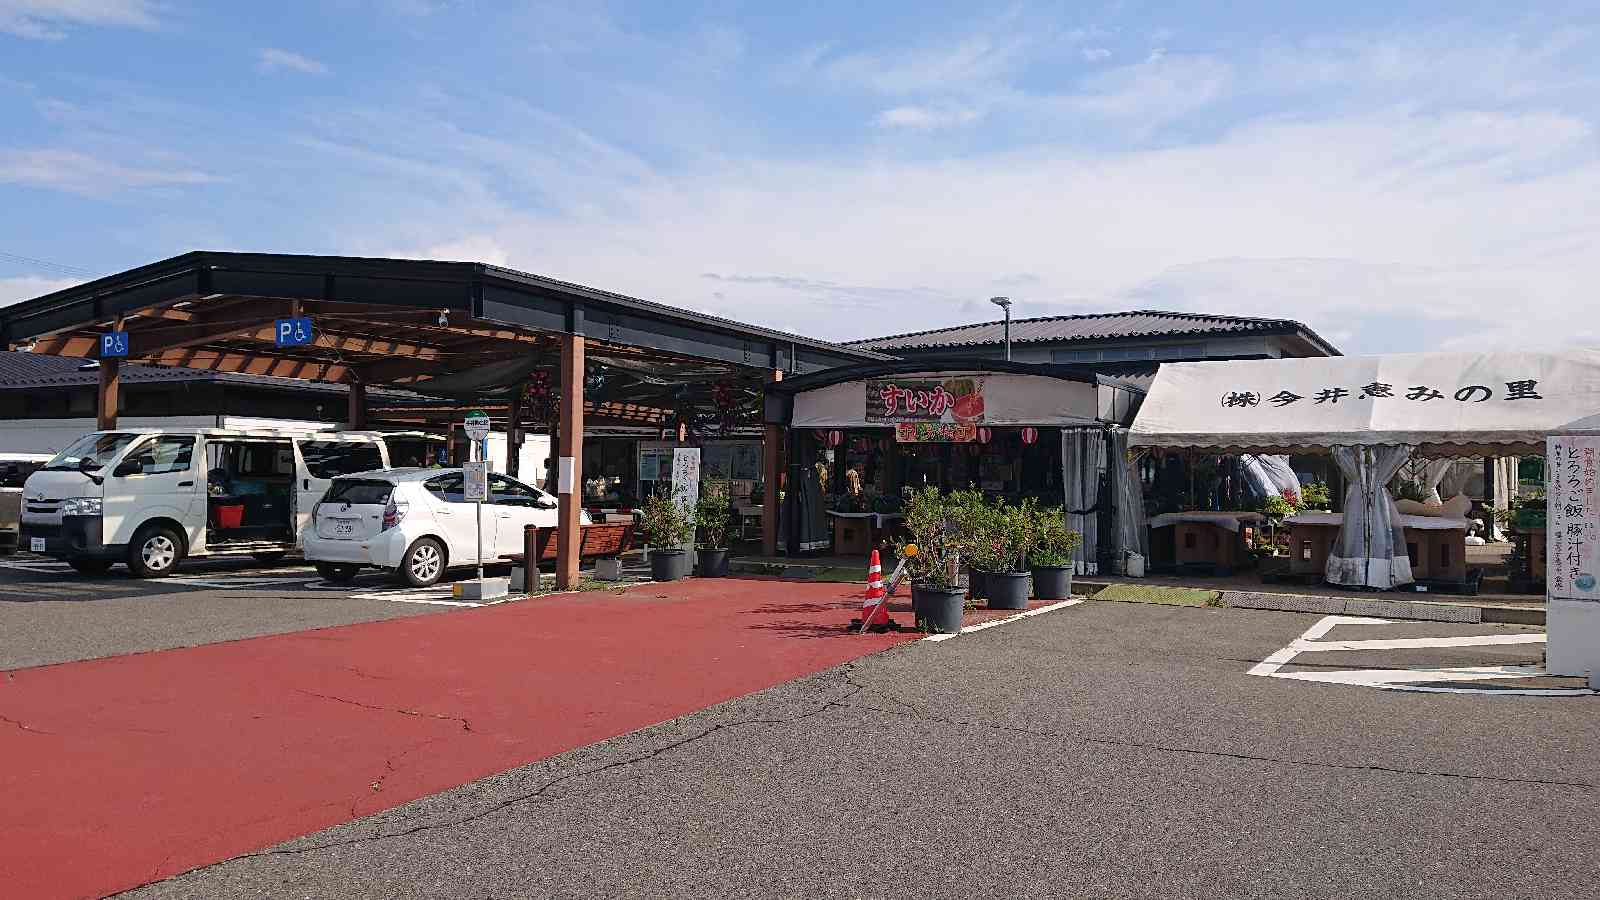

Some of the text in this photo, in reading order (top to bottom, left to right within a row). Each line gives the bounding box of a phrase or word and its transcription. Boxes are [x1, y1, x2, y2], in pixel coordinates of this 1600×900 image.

[280, 322, 292, 343] P
[104, 336, 114, 353] P
[880, 383, 955, 417] すいか
